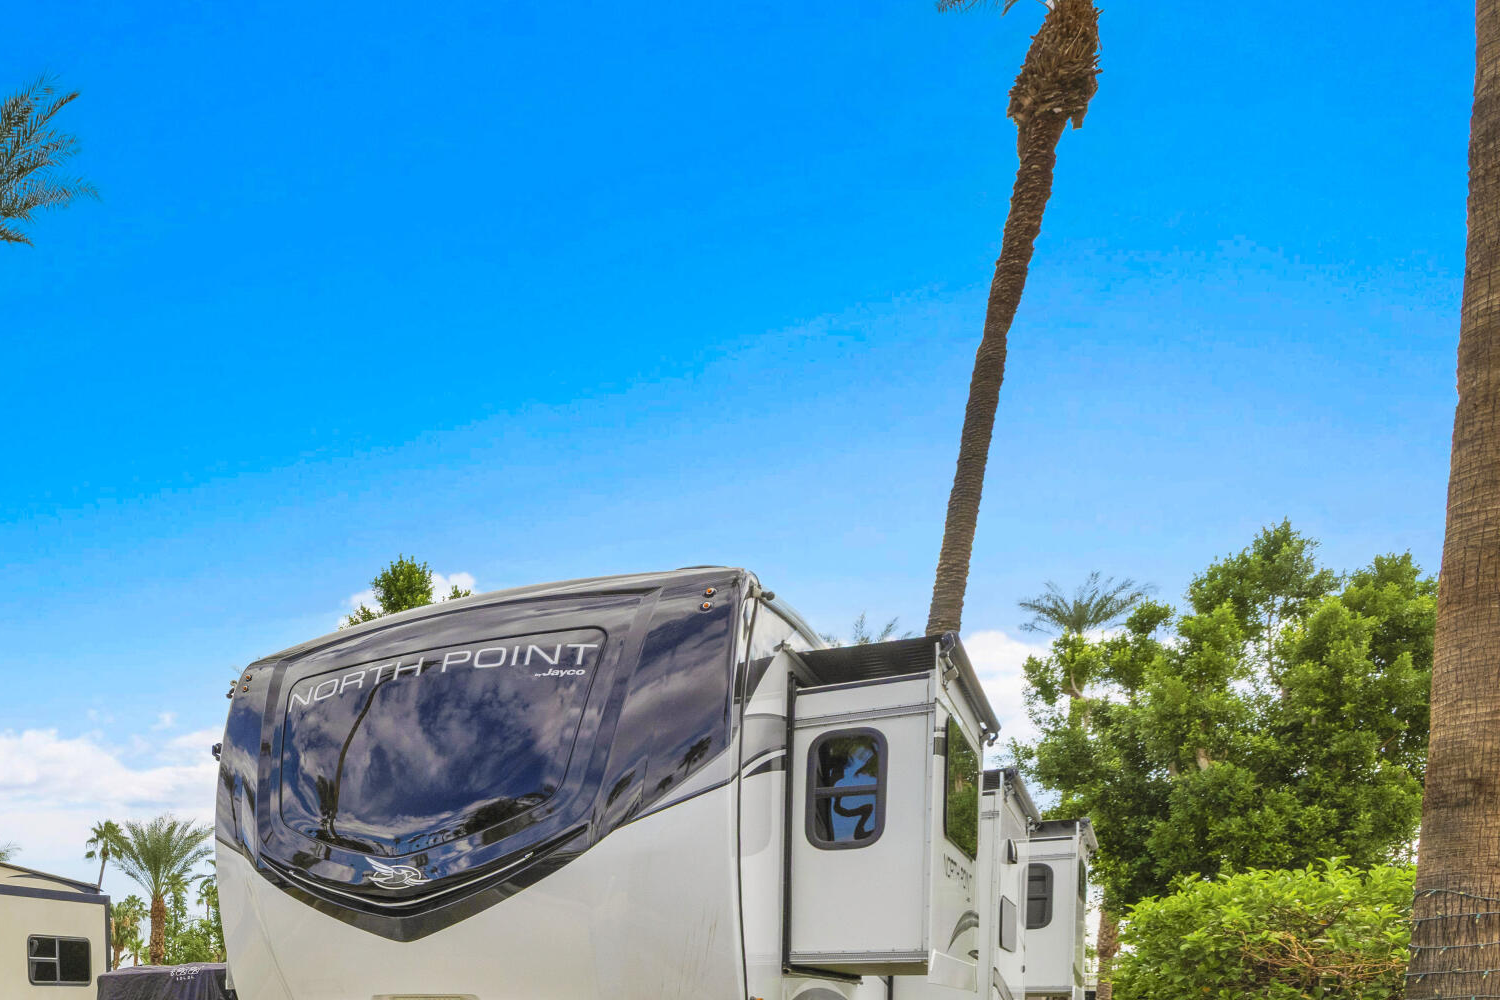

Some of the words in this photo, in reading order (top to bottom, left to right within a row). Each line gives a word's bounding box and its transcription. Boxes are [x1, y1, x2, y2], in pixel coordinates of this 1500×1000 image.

[287, 656, 425, 713] NORTH
[441, 643, 598, 673] POINT
[542, 668, 586, 677] Jayco
